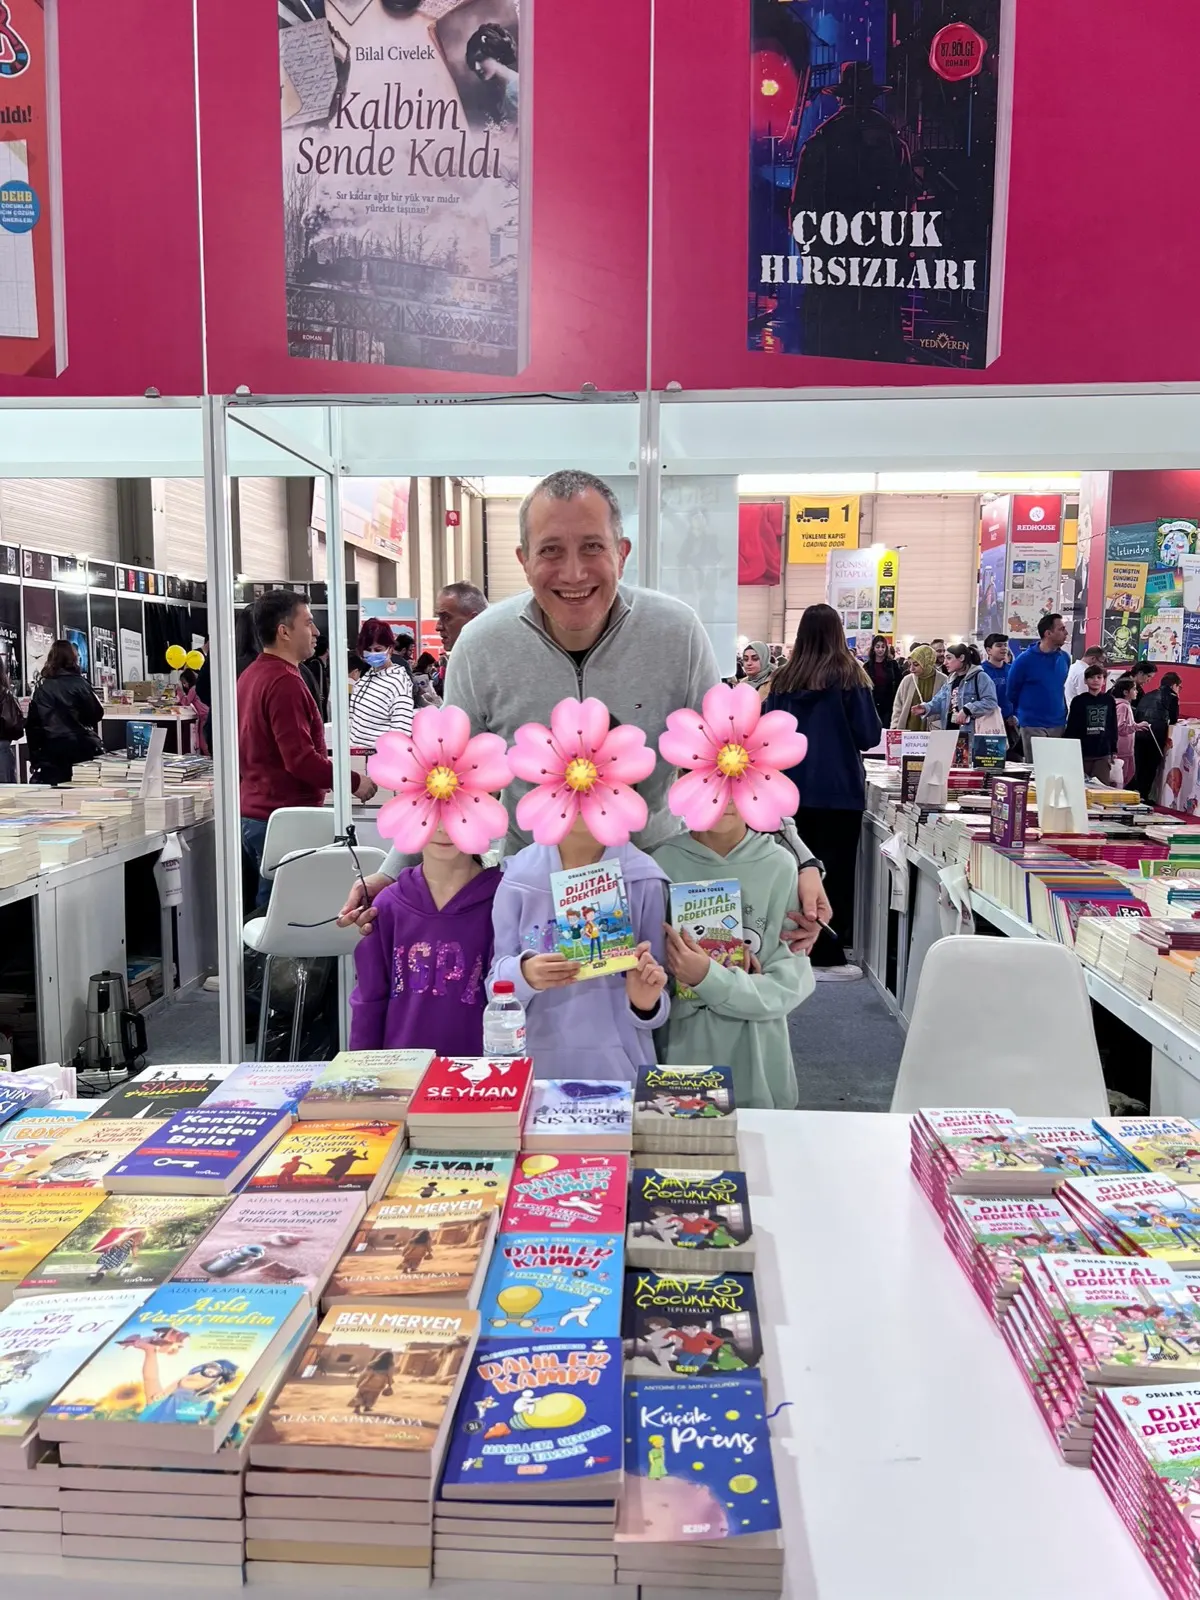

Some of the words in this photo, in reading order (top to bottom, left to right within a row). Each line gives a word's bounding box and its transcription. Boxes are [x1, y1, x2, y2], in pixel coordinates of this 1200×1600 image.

[355, 45, 387, 62] Bilal
[388, 45, 436, 62] Civelek
[334, 83, 460, 131] Kalbim
[297, 132, 394, 177] Sende
[408, 132, 500, 179] Kaldı
[1, 191, 33, 202] DEHB
[336, 190, 347, 200] Sır
[349, 190, 372, 201] kadar
[391, 192, 403, 201] bir
[405, 193, 419, 204] yük
[437, 194, 460, 204] mıdır
[365, 204, 395, 214] yürekte
[397, 204, 430, 216] taşınan?
[793, 210, 942, 255] ÇOCUK
[760, 253, 976, 290] HIRSIZLARI
[302, 334, 323, 342] ROMAN
[841, 504, 850, 522] 1
[802, 532, 827, 540] YÜKLEME
[802, 540, 828, 548] LOADING
[568, 872, 587, 880] ORHAN
[587, 867, 605, 877] TOKER
[559, 880, 619, 908] DEDEKTİFLER
[677, 902, 737, 924] DEDEKTİFLER
[426, 1086, 518, 1098] SEYHAN
[182, 1115, 267, 1126] Kendini
[937, 1118, 1014, 1128] DEDEKTİFLER
[168, 1124, 257, 1137] Yeniden
[1118, 1128, 1193, 1138] DEDEKTİFLER
[166, 1135, 237, 1147] Başlat
[644, 1190, 736, 1204] ÇOCUKLARI
[1095, 1185, 1179, 1203] DEDEKTİFLER
[378, 1204, 412, 1216] BEN
[415, 1199, 484, 1214] MERYEM
[973, 1210, 1063, 1222] DEDEKTİFLER
[512, 1256, 603, 1272] KAMPI
[1073, 1268, 1158, 1278] DİJİTAL
[1065, 1278, 1172, 1287] DEDEKTİFLER
[168, 1287, 210, 1296] ALİŞAN
[210, 1288, 288, 1296] KAPAKLIKAYA
[177, 1296, 250, 1313] Asla
[636, 1294, 742, 1312] ÇOCUKLARI
[139, 1308, 276, 1326] Vazgeçmedim
[336, 1312, 377, 1327] BEN
[380, 1314, 462, 1331] MERYEM
[0, 1322, 73, 1338] anımda
[492, 1368, 601, 1394] KAMPI
[1146, 1390, 1184, 1399] ORHAN
[1188, 1390, 1200, 1398] TO
[278, 1414, 328, 1424] ALİŞAN
[330, 1414, 423, 1427] KAPAKLIKAYA
[640, 1406, 712, 1428] Küçük
[671, 1426, 758, 1455] Prens
